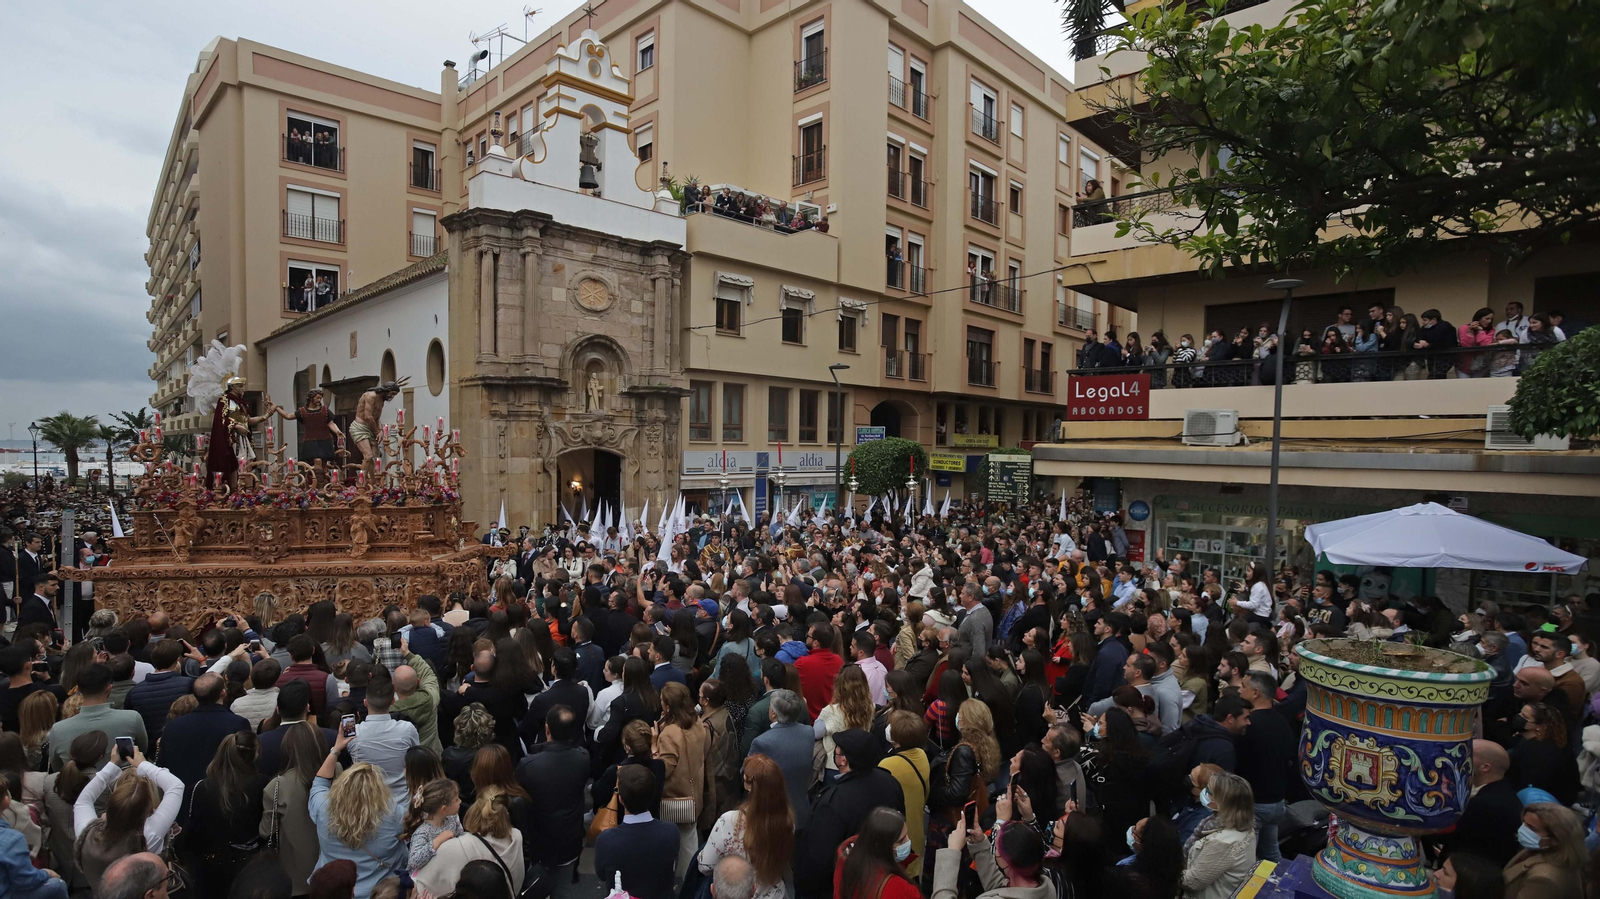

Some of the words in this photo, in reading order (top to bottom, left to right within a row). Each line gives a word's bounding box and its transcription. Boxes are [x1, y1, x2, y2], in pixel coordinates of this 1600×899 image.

[1075, 381, 1141, 402] Legal4
[1072, 406, 1143, 415] ABOGADOS
[1192, 502, 1271, 516] ACCESORIOS
[1277, 506, 1313, 518] PARA
